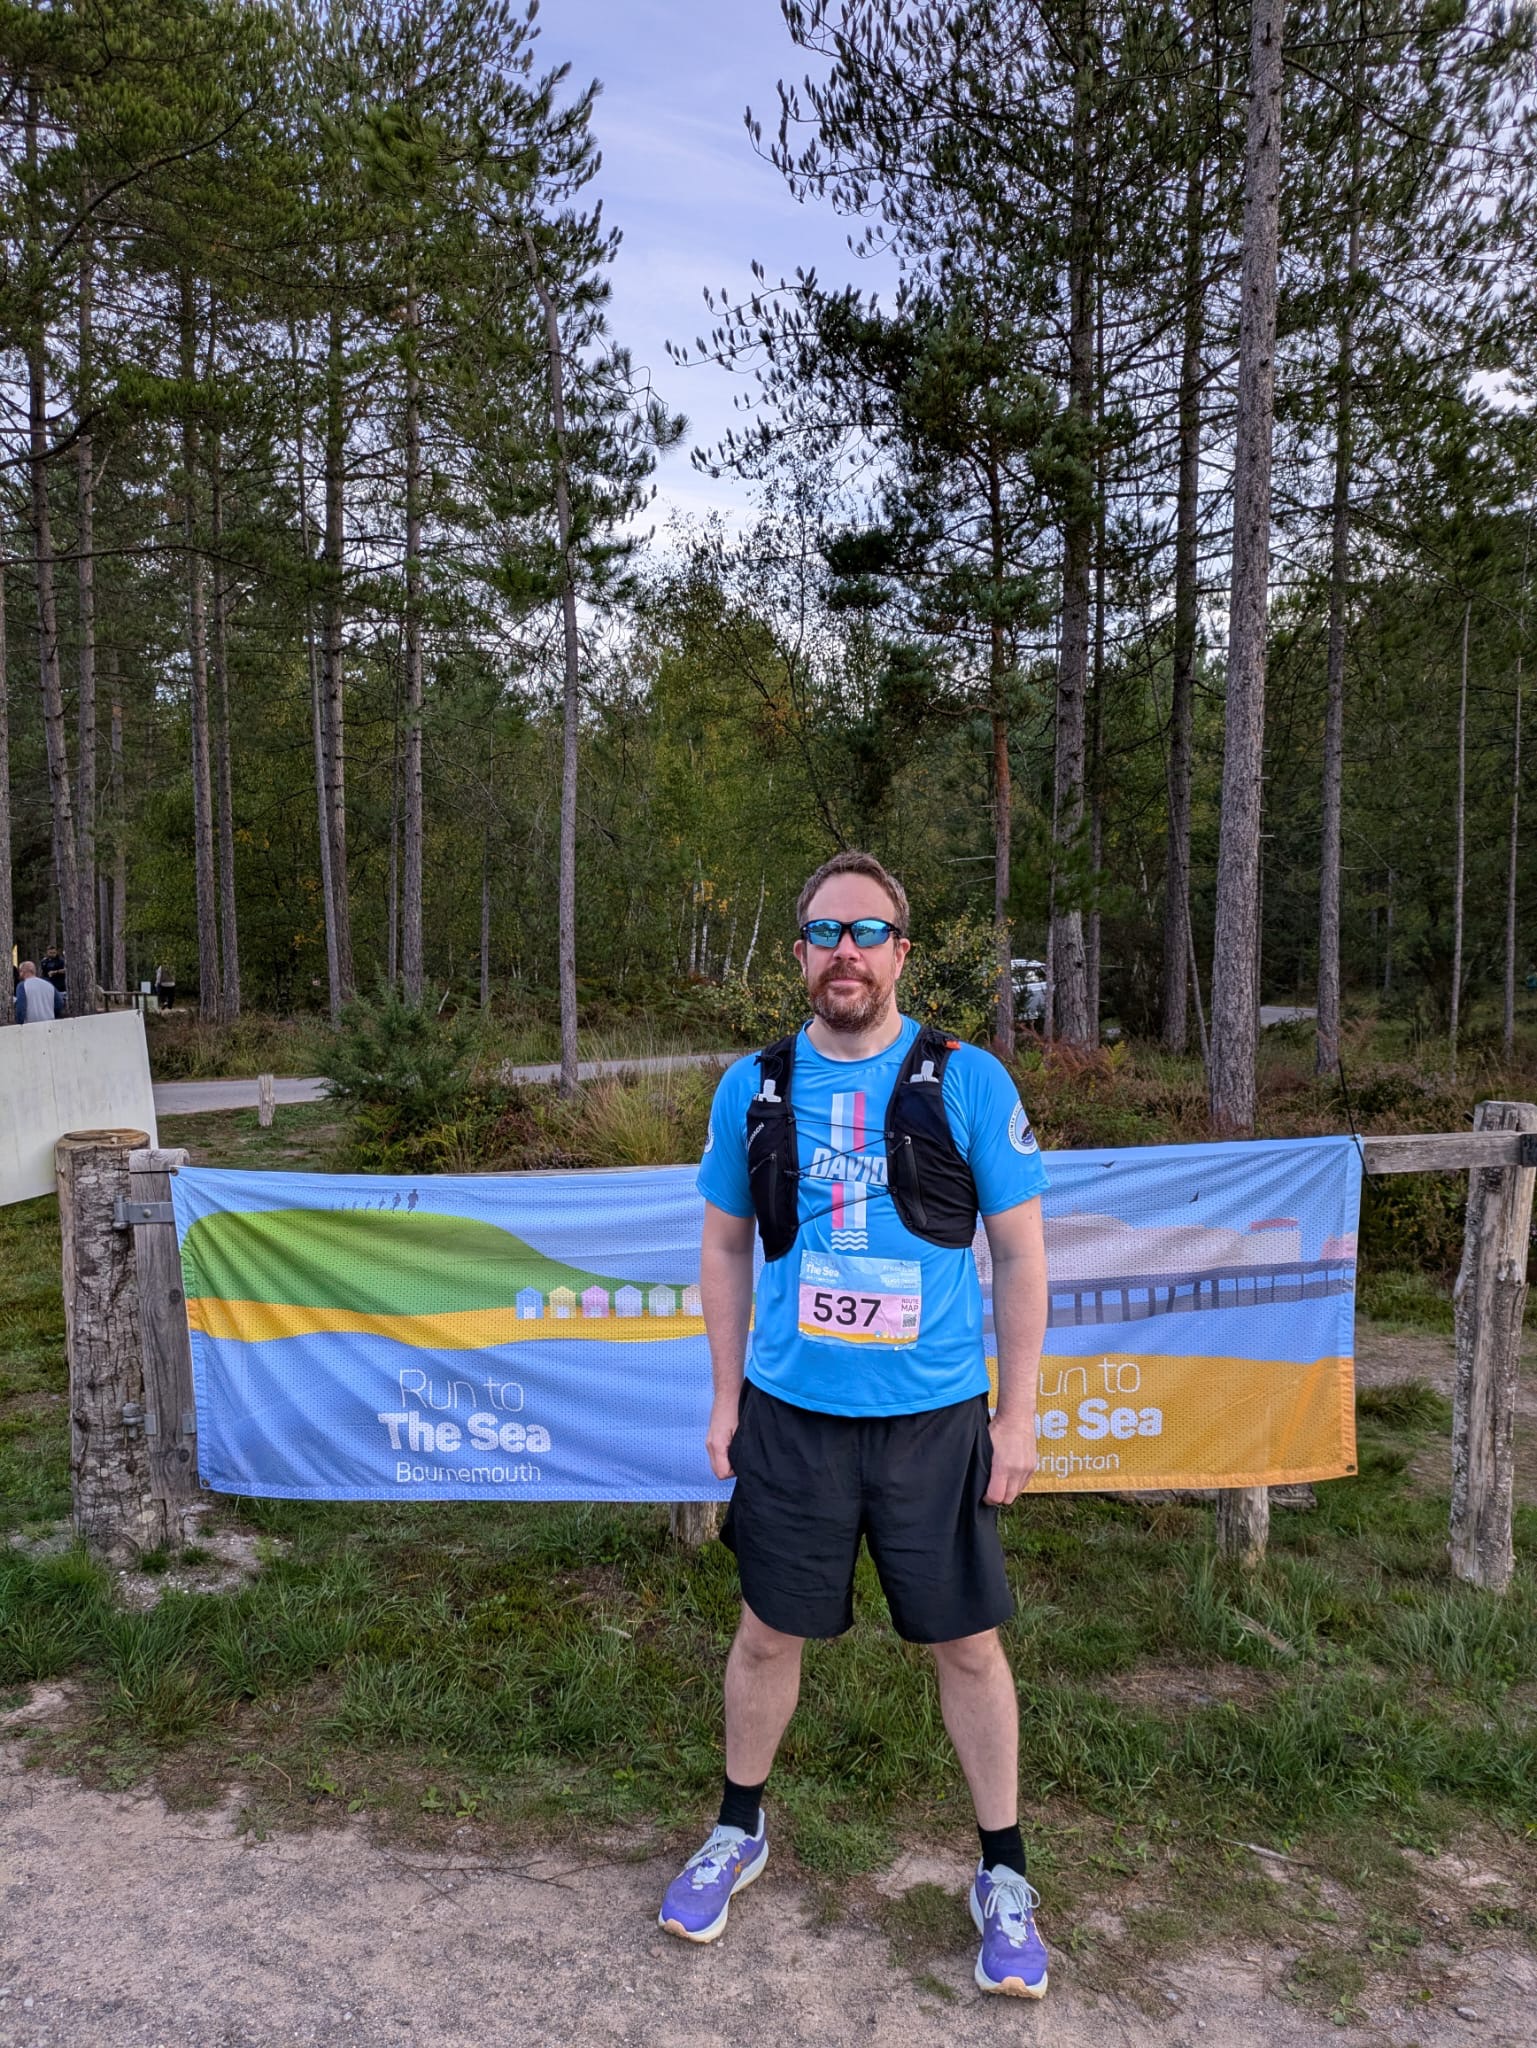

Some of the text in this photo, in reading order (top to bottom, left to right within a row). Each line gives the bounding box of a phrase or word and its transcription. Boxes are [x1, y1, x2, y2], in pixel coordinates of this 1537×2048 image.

[809, 1147, 889, 1186] DAVID
[813, 1292, 882, 1328] 537
[901, 1304, 919, 1312] MAP
[400, 1369, 524, 1412] Run to
[1039, 1357, 1141, 1396] un to
[377, 1410, 551, 1453] The Sea
[1077, 1398, 1162, 1440] Sea
[396, 1461, 541, 1483] Bournemouth
